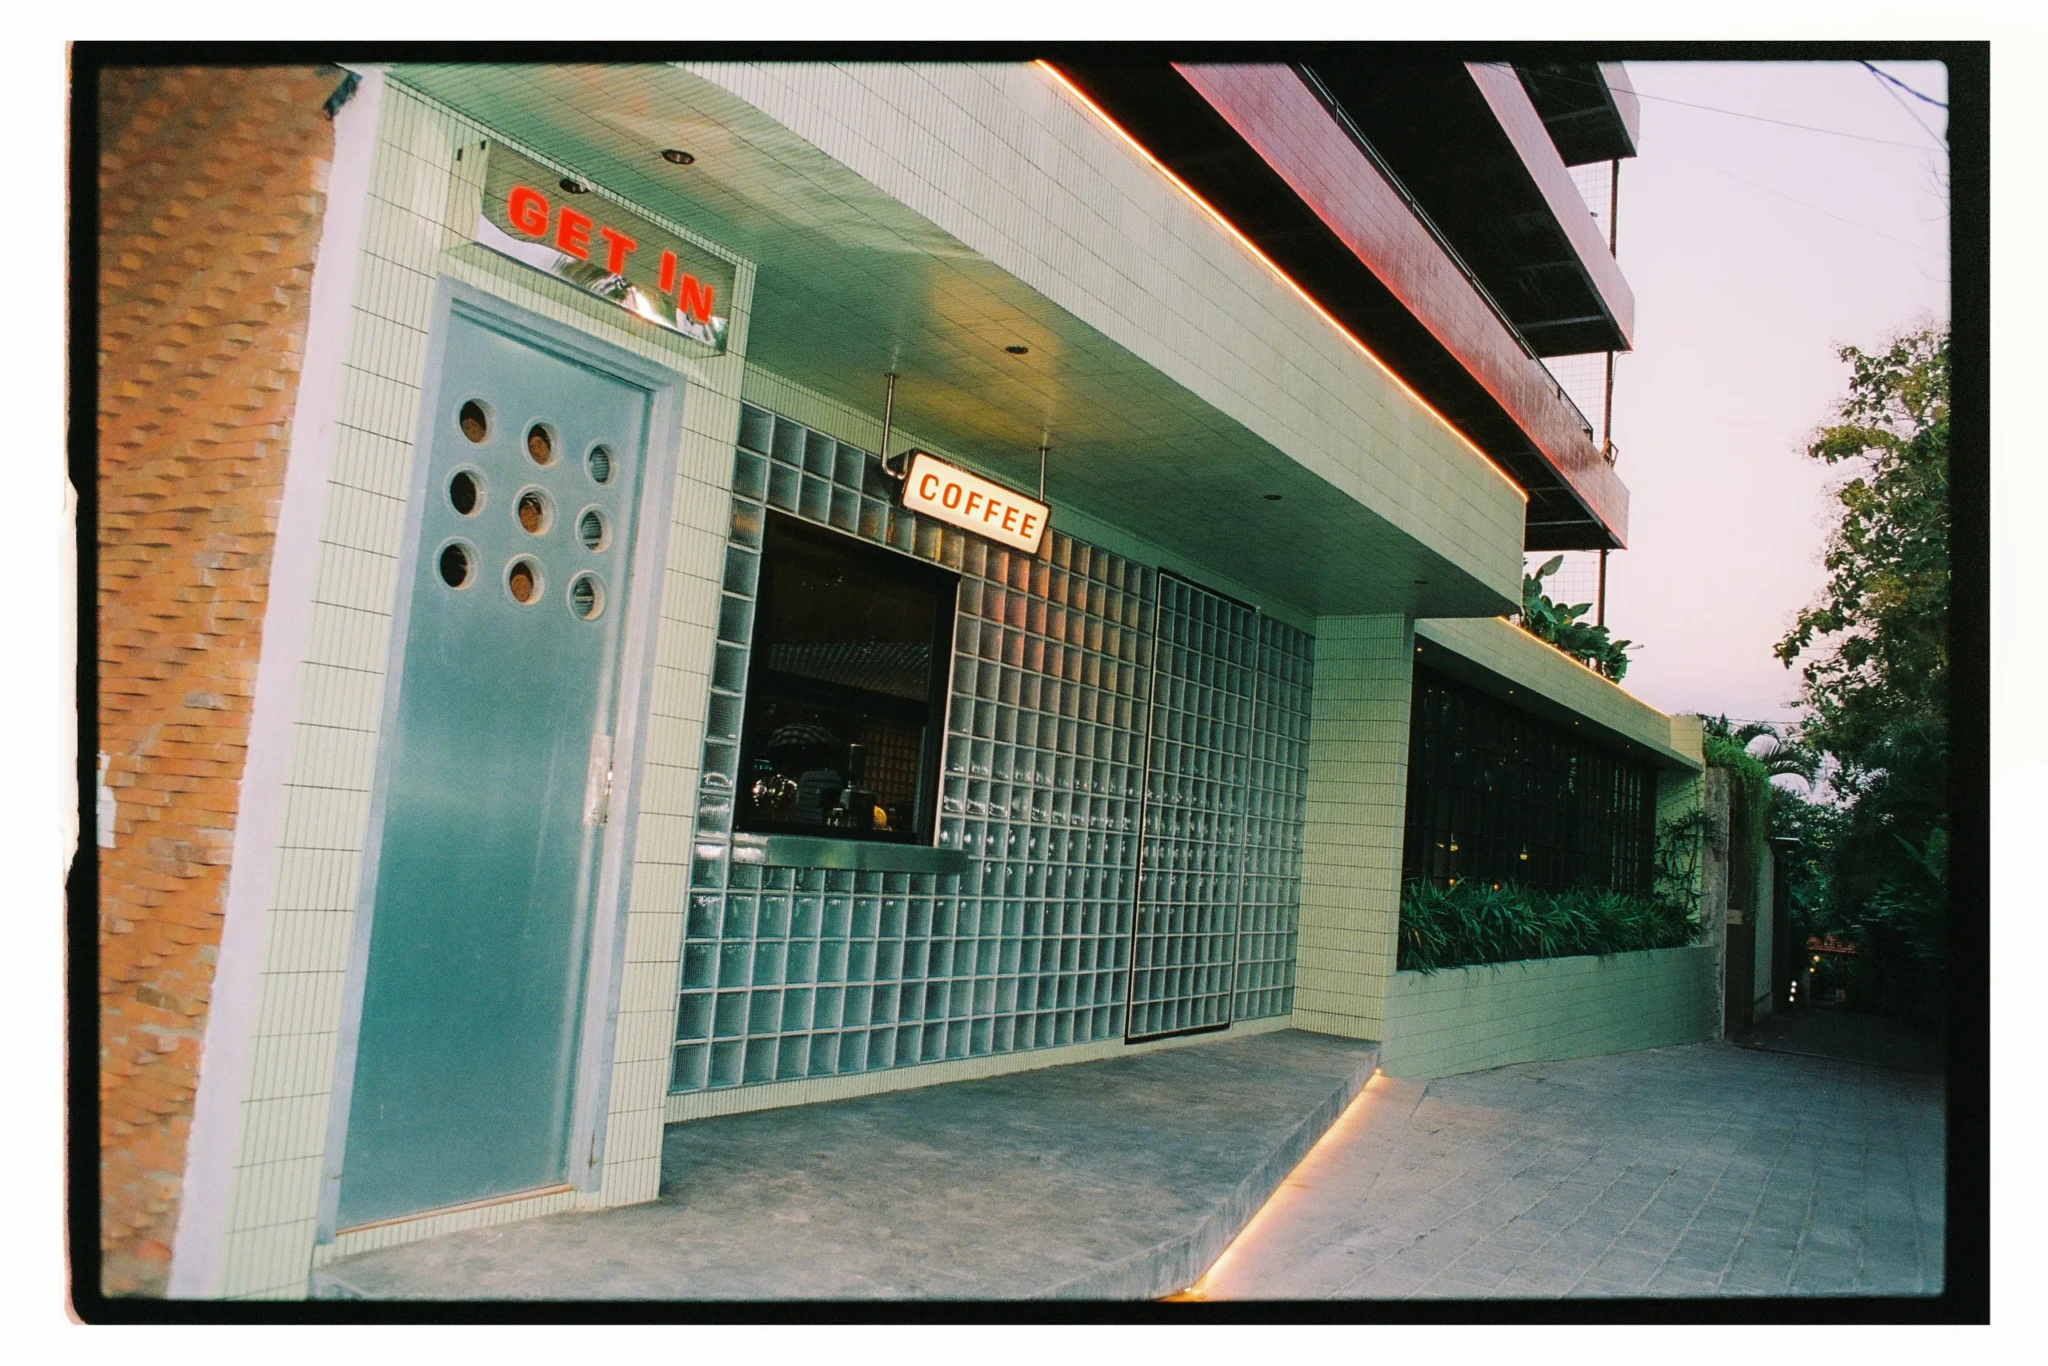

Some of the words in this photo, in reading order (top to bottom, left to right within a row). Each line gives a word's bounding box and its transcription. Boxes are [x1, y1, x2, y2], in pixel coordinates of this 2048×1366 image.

[508, 185, 637, 275] GET
[658, 250, 713, 324] IN
[919, 473, 1037, 539] COFFEE
